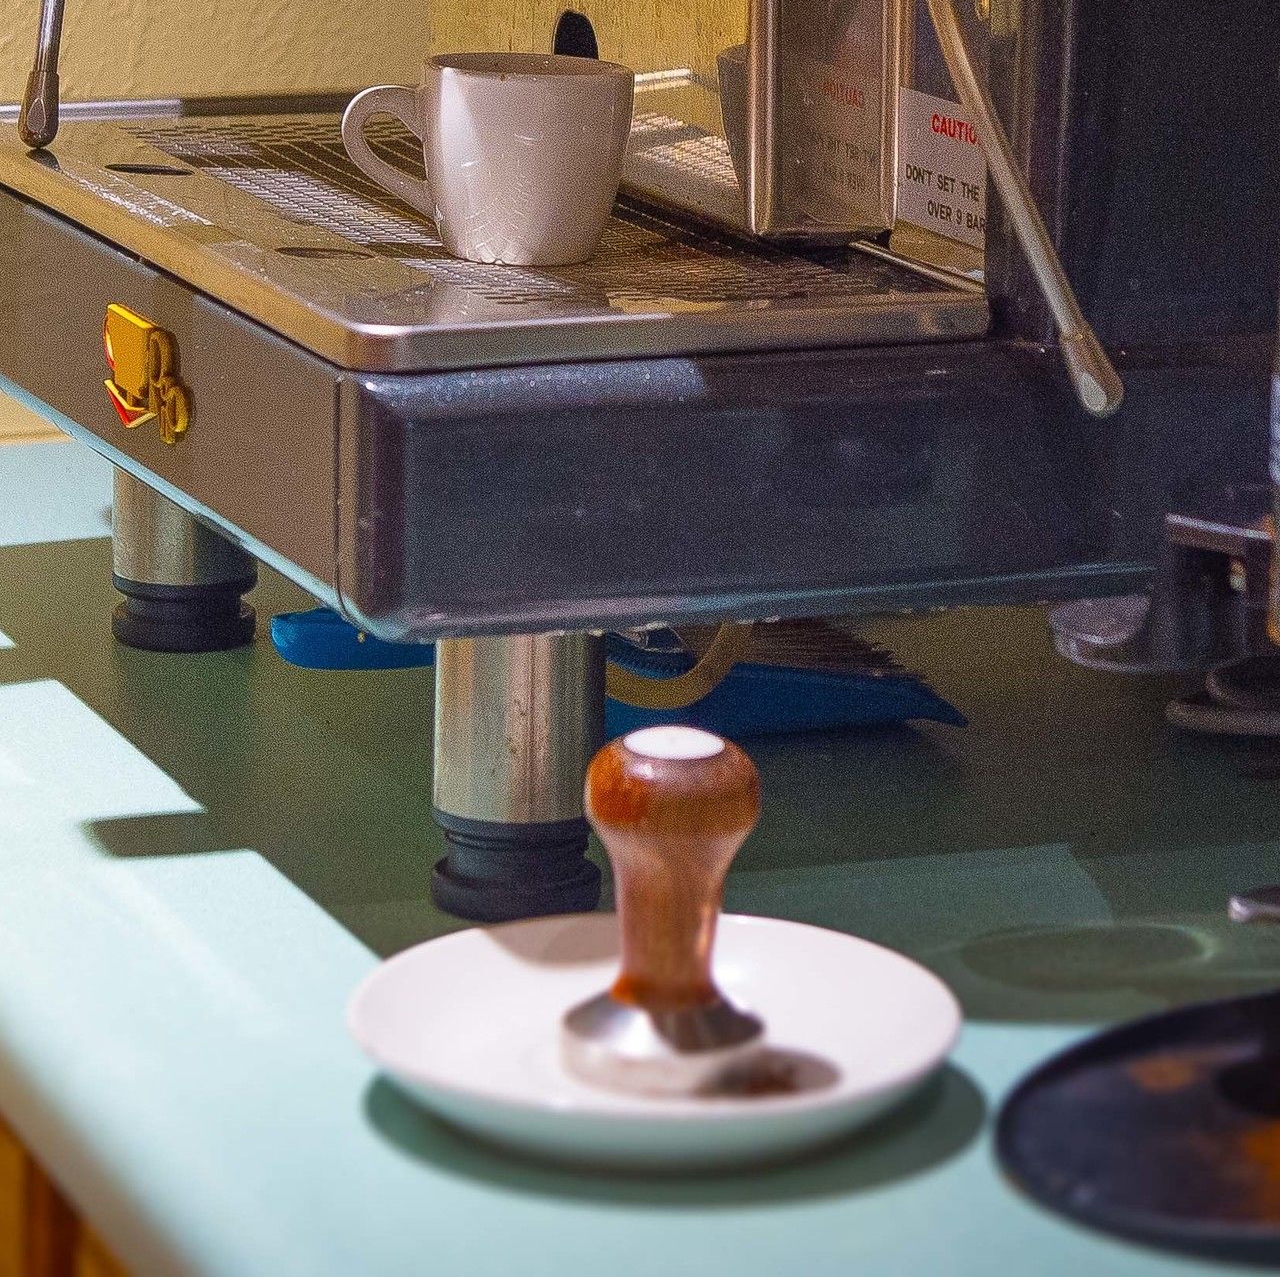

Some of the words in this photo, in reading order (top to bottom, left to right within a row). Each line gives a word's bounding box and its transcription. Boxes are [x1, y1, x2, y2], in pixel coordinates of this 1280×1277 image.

[936, 174, 955, 195] SET
[960, 180, 980, 203] THE
[927, 199, 953, 223] OVER
[955, 208, 963, 225] 9
